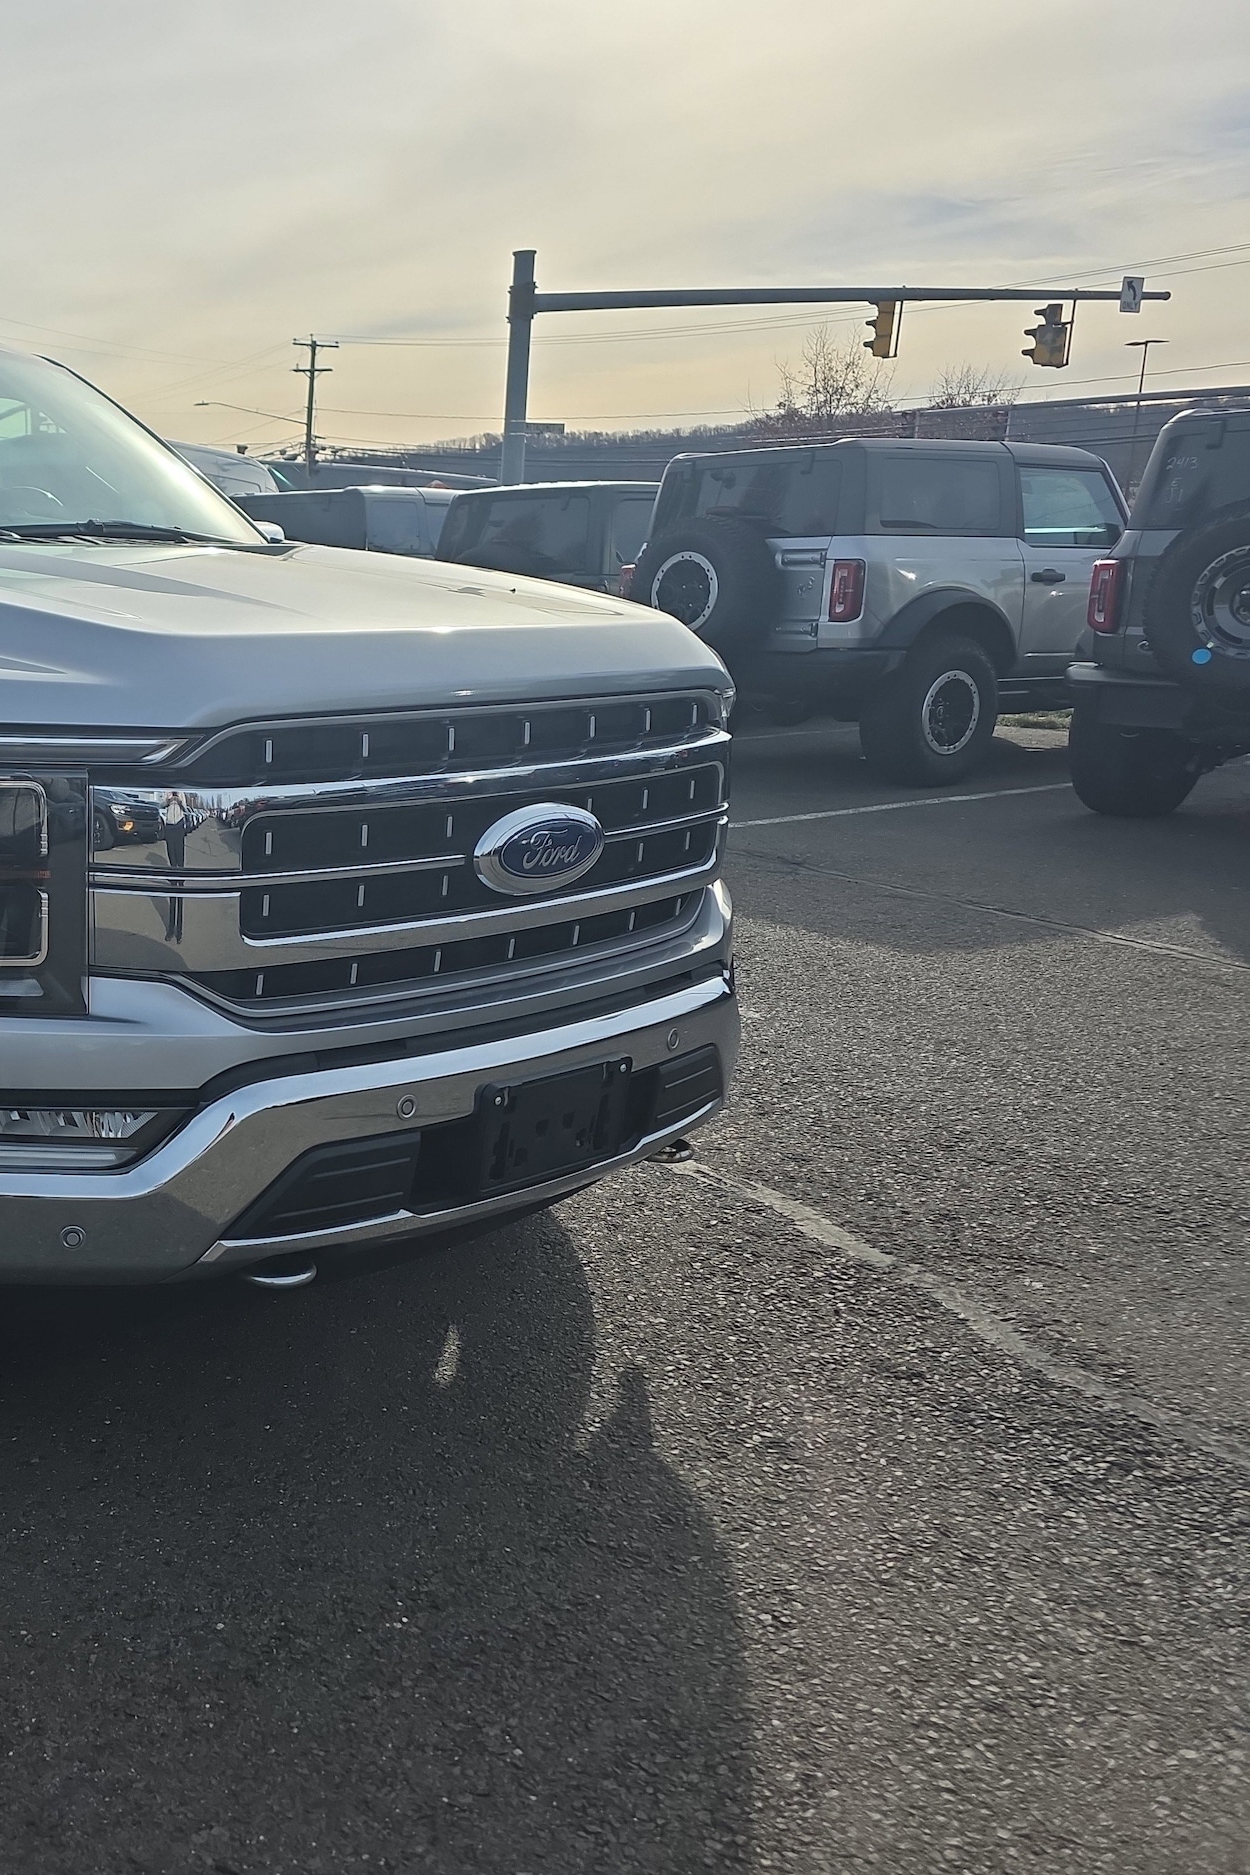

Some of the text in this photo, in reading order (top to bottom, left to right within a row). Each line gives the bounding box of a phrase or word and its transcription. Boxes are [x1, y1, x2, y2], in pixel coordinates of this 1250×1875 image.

[1122, 300, 1139, 310] ONLY
[1165, 456, 1199, 470] 2413
[520, 828, 583, 870] Ford
